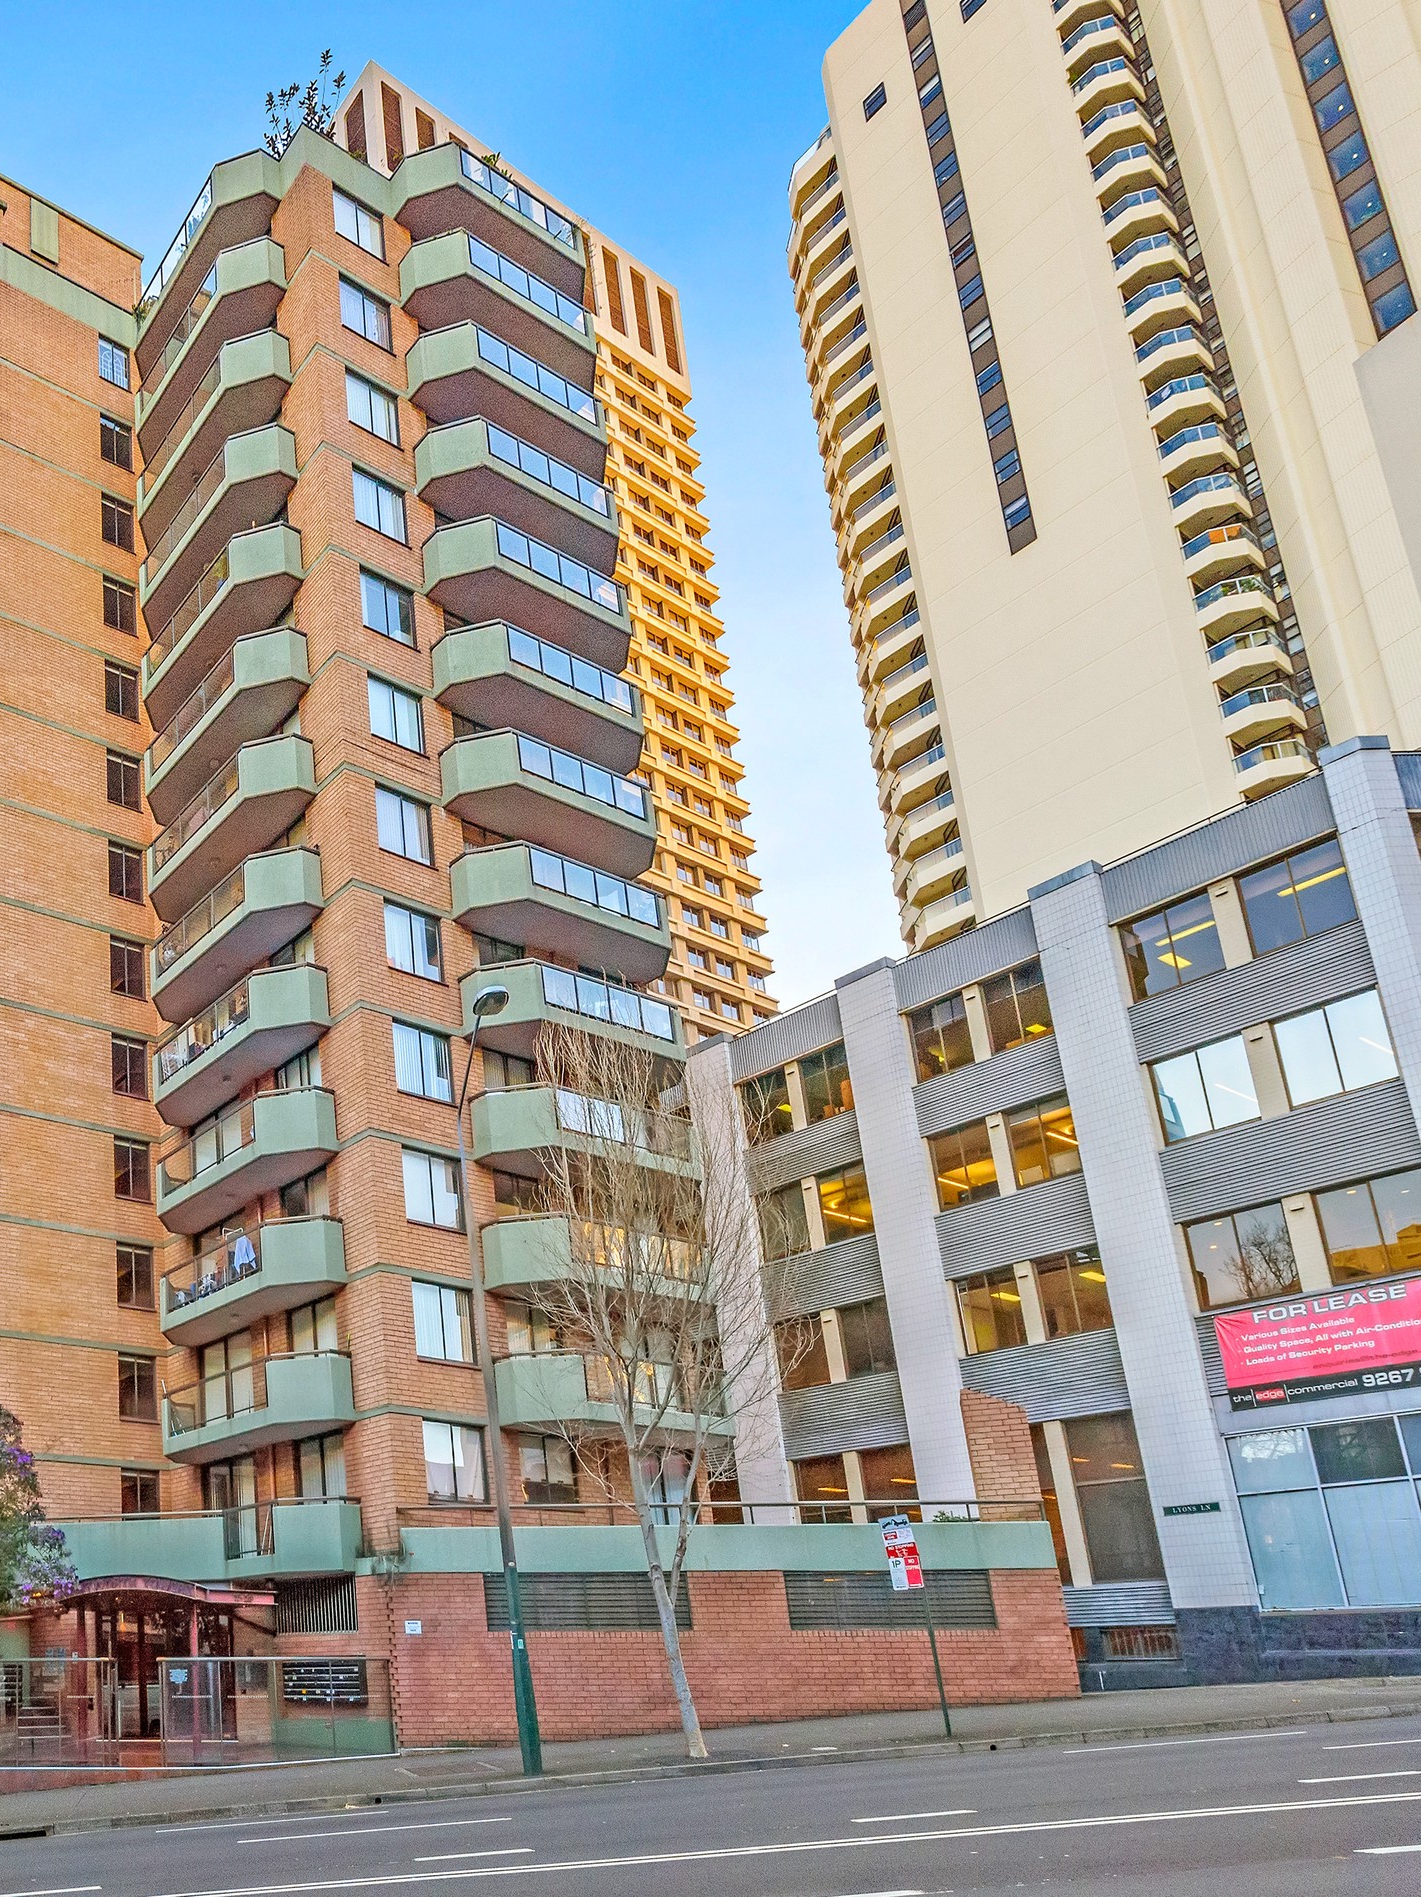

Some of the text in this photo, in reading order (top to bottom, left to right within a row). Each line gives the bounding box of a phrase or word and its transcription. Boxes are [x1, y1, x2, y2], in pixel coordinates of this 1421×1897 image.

[1252, 1284, 1408, 1325] FOR LEASE
[1241, 1316, 1355, 1341] Various Sizes Available
[1243, 1319, 1421, 1354] Quality Space, All with Air-Conditio
[1246, 1340, 1376, 1366] Loads of Security Parking
[1232, 1393, 1253, 1403] the
[1255, 1389, 1285, 1400] edge
[1287, 1378, 1359, 1396] commercial
[1361, 1368, 1414, 1387] 9267
[1172, 1506, 1197, 1514] LYONS
[891, 1560, 901, 1568] 1P
